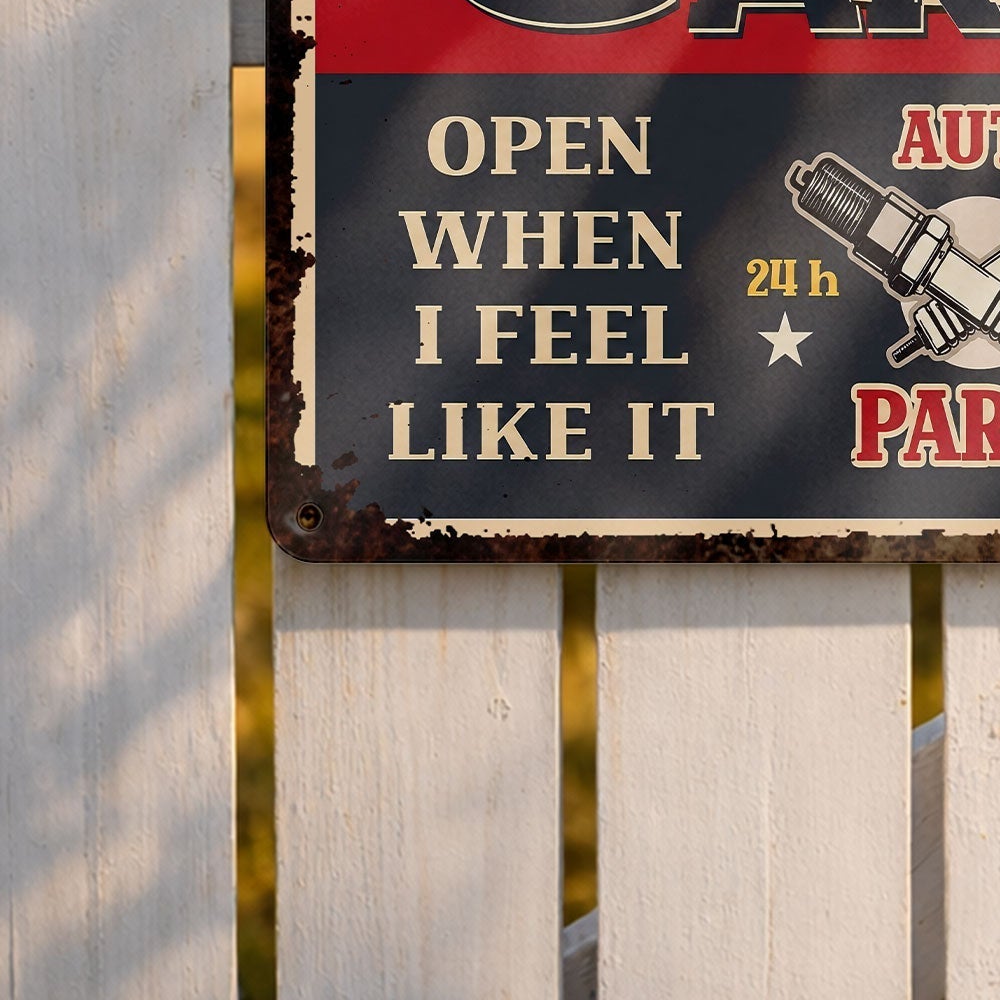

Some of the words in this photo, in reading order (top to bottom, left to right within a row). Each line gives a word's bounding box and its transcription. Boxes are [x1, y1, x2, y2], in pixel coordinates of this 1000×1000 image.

[426, 115, 652, 176] OPEN
[398, 210, 682, 270] WHEN
[746, 258, 798, 297] 24
[808, 258, 840, 297] h
[414, 304, 444, 365] I
[475, 304, 689, 365] FEEL
[387, 402, 593, 461] LIKE
[627, 402, 715, 461] IT
